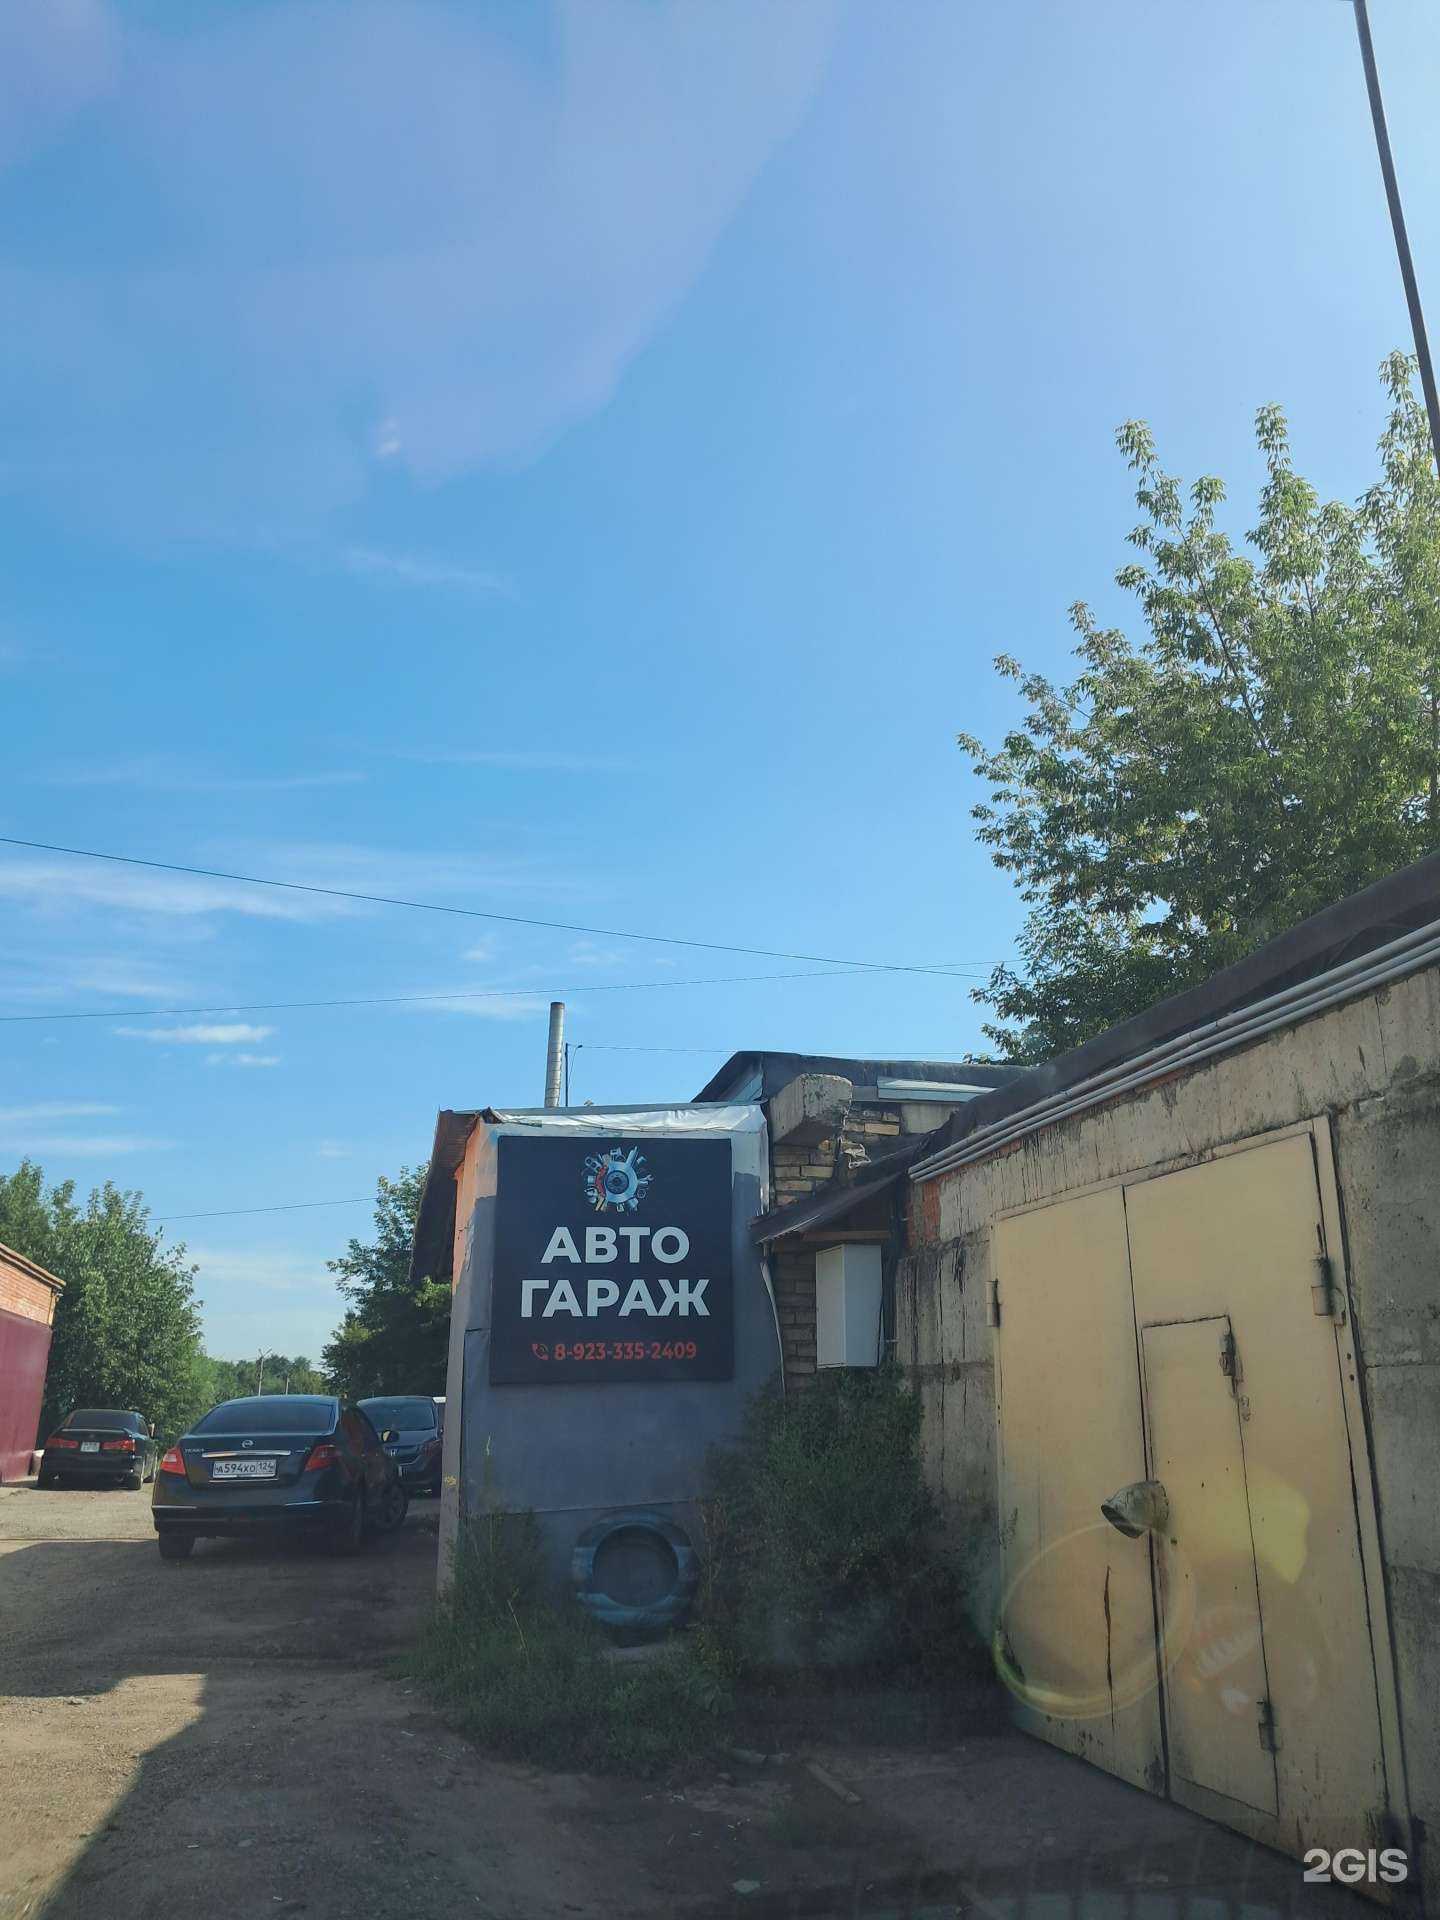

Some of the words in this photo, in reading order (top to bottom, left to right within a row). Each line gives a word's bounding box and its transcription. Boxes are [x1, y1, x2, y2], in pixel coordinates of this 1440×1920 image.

[541, 1226, 690, 1264] АВТО
[521, 1279, 711, 1317] ГАРАЖ
[554, 1342, 697, 1361] 8-923-335-2409
